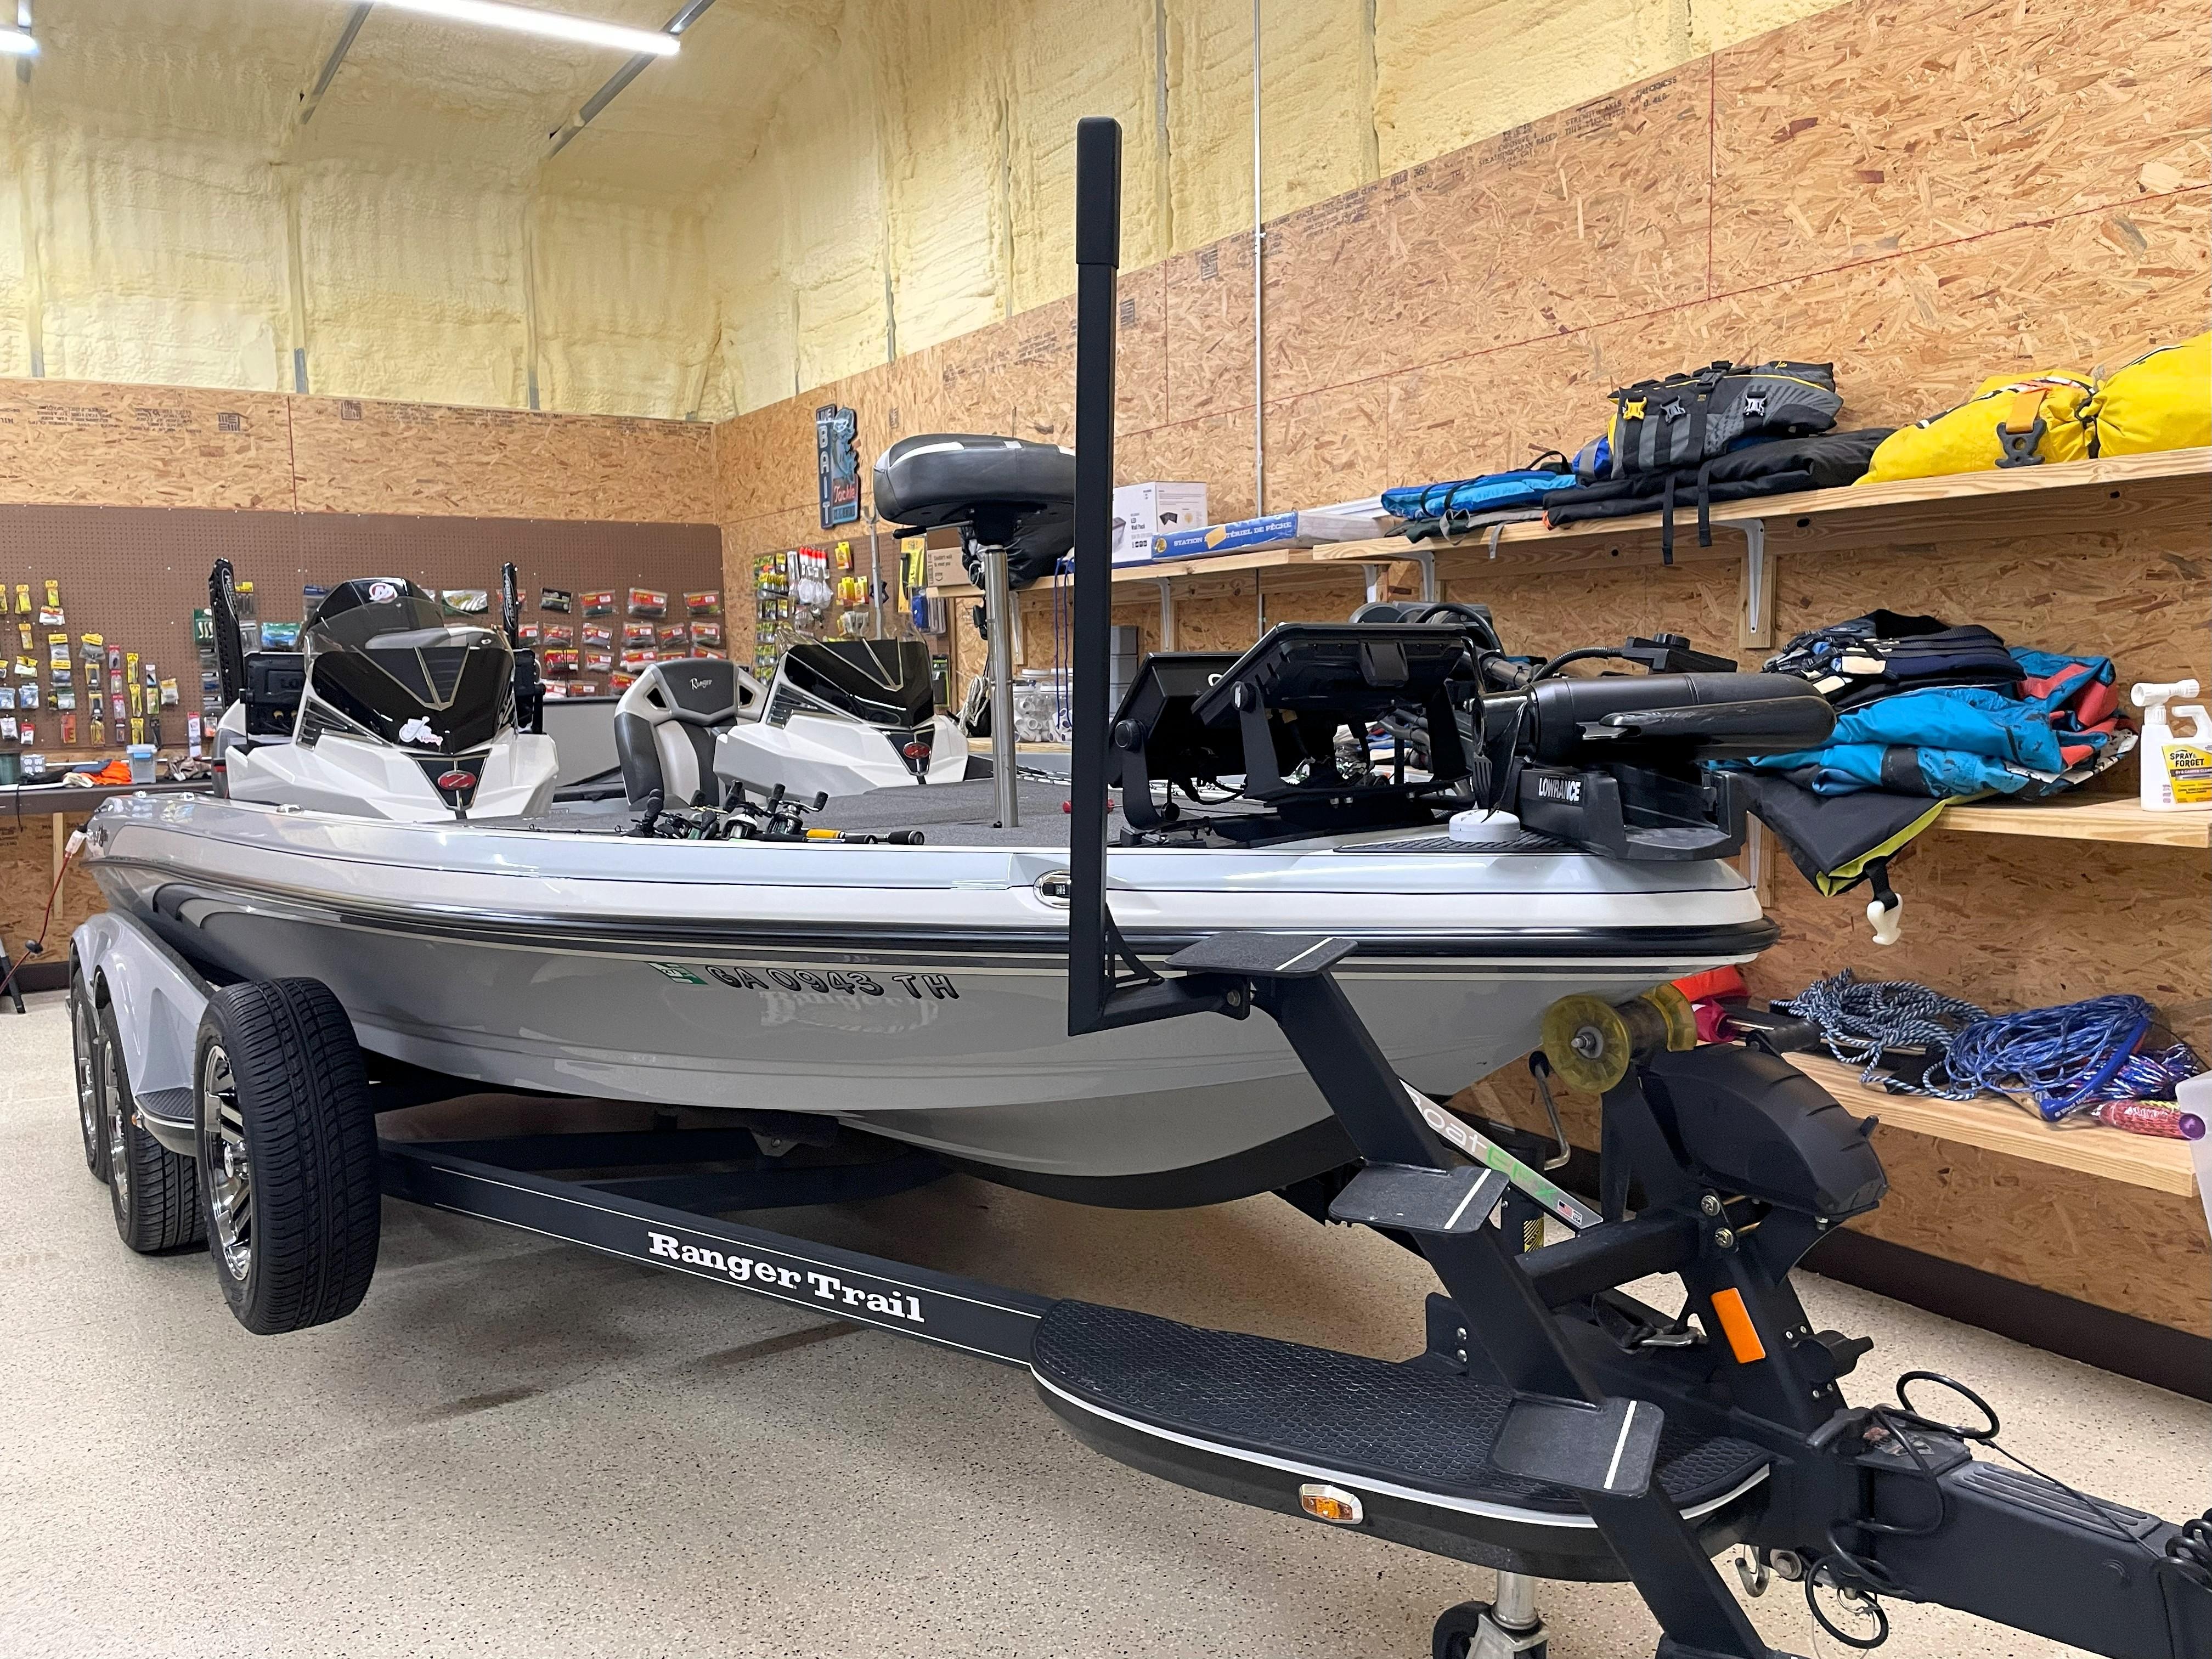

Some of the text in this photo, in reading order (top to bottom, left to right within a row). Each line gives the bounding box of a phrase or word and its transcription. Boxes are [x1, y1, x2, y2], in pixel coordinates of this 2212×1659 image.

[818, 425, 831, 524] BAIT
[834, 483, 856, 504] Tackle
[1173, 537, 1204, 546] STATION
[1265, 521, 1292, 532] PÊCHE
[689, 677, 713, 691] Ranger
[2170, 752, 2193, 760] SPRAY
[2175, 758, 2204, 768] FORGET
[1538, 777, 1581, 802] LOWRANCE
[705, 966, 769, 989] GA
[766, 967, 884, 996] 0943
[891, 974, 960, 1000] TH
[647, 1231, 925, 1323] Ranger Trail
